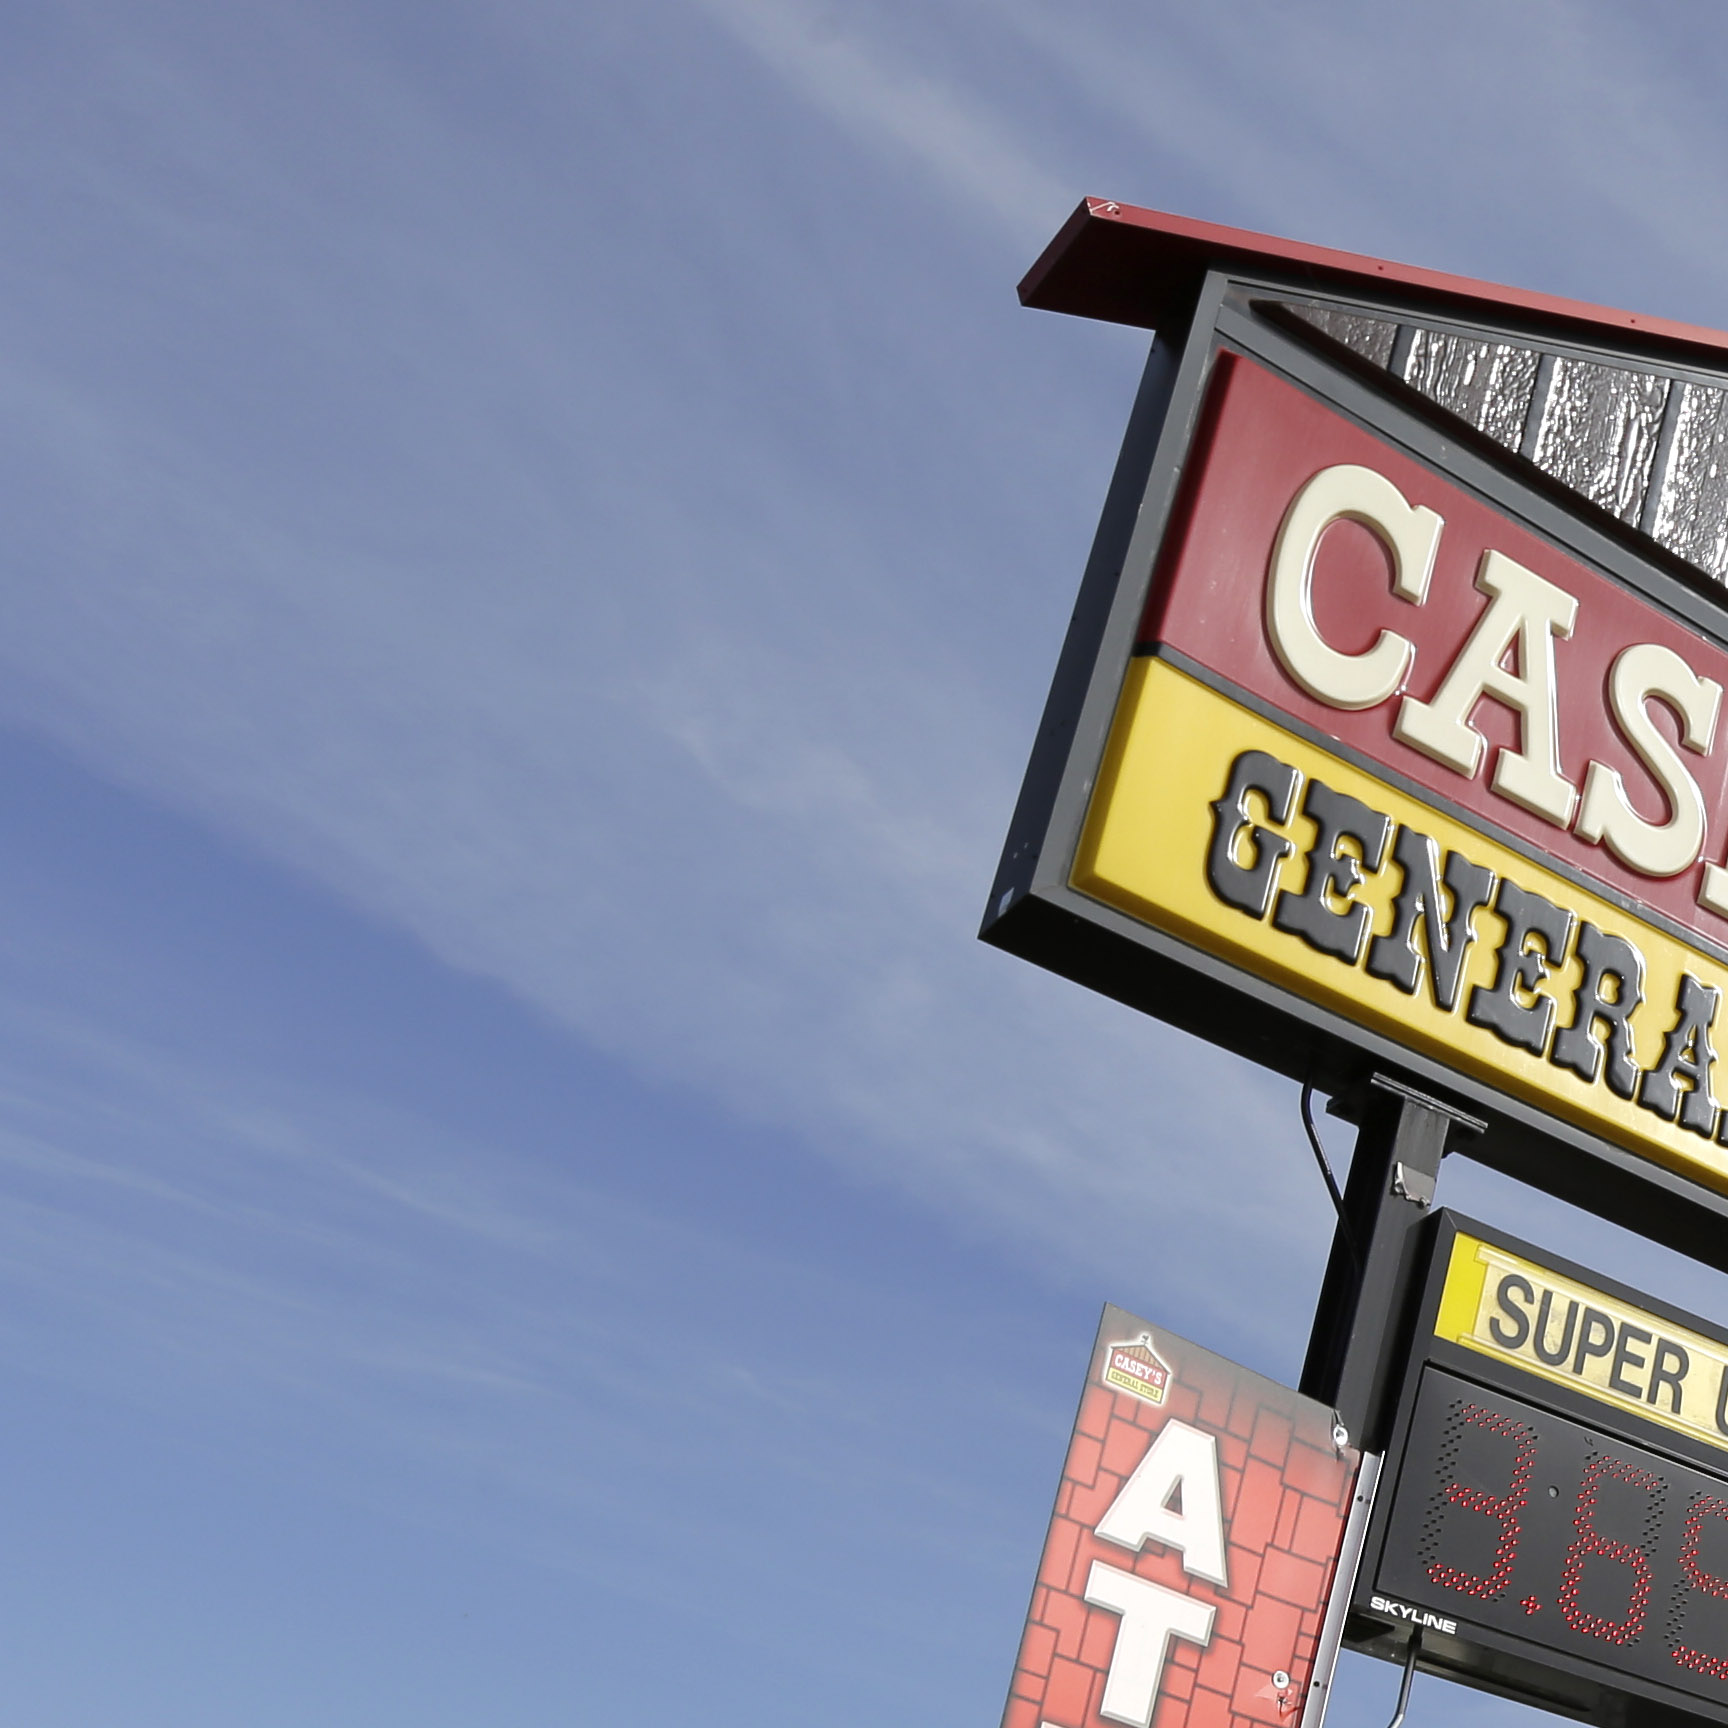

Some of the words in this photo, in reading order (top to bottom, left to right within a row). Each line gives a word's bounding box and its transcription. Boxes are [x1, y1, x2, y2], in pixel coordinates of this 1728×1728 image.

[1488, 1273, 1690, 1416] SUPER
[1114, 1354, 1163, 1385] CASEY'S
[1369, 1595, 1458, 1635] SKYLINE
